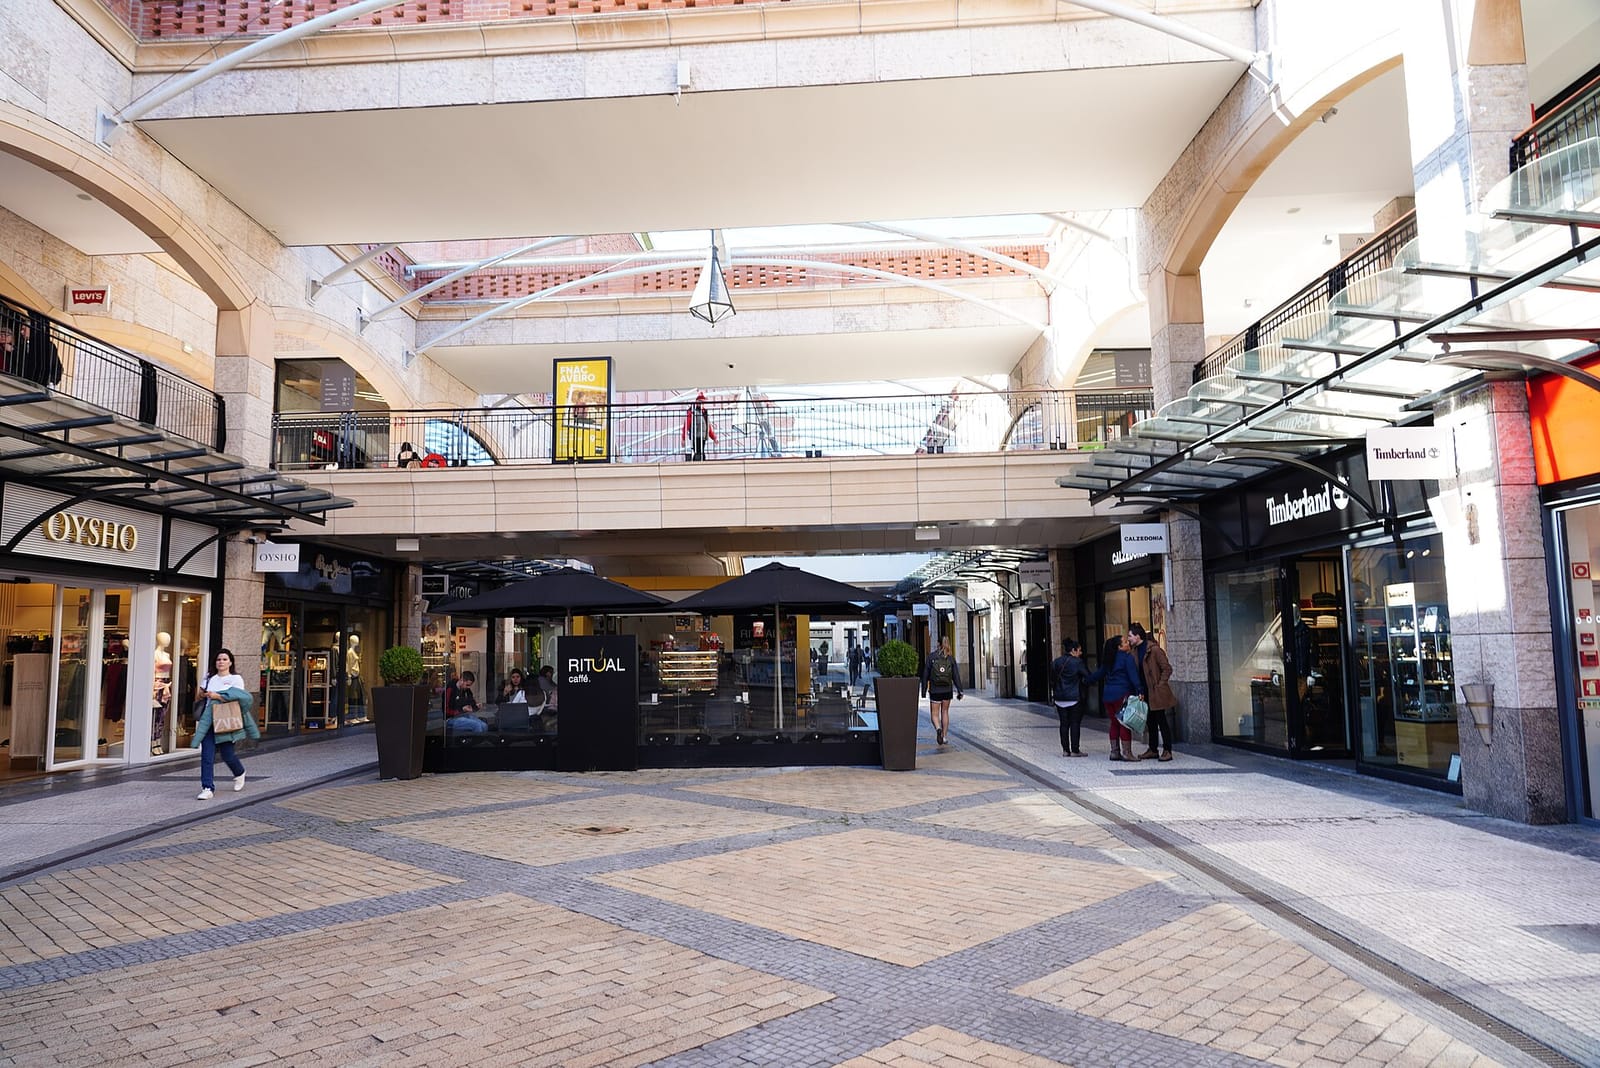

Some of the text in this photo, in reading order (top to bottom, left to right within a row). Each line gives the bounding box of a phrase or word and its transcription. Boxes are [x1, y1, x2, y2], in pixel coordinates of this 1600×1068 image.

[560, 366, 588, 375] FNAC
[560, 373, 596, 383] AVEIRO
[1373, 448, 1426, 460] Timberland
[1266, 481, 1332, 526] Timberland
[46, 511, 138, 551] OYSHO
[260, 553, 297, 562] OYSHO
[568, 657, 626, 673] RITUAL
